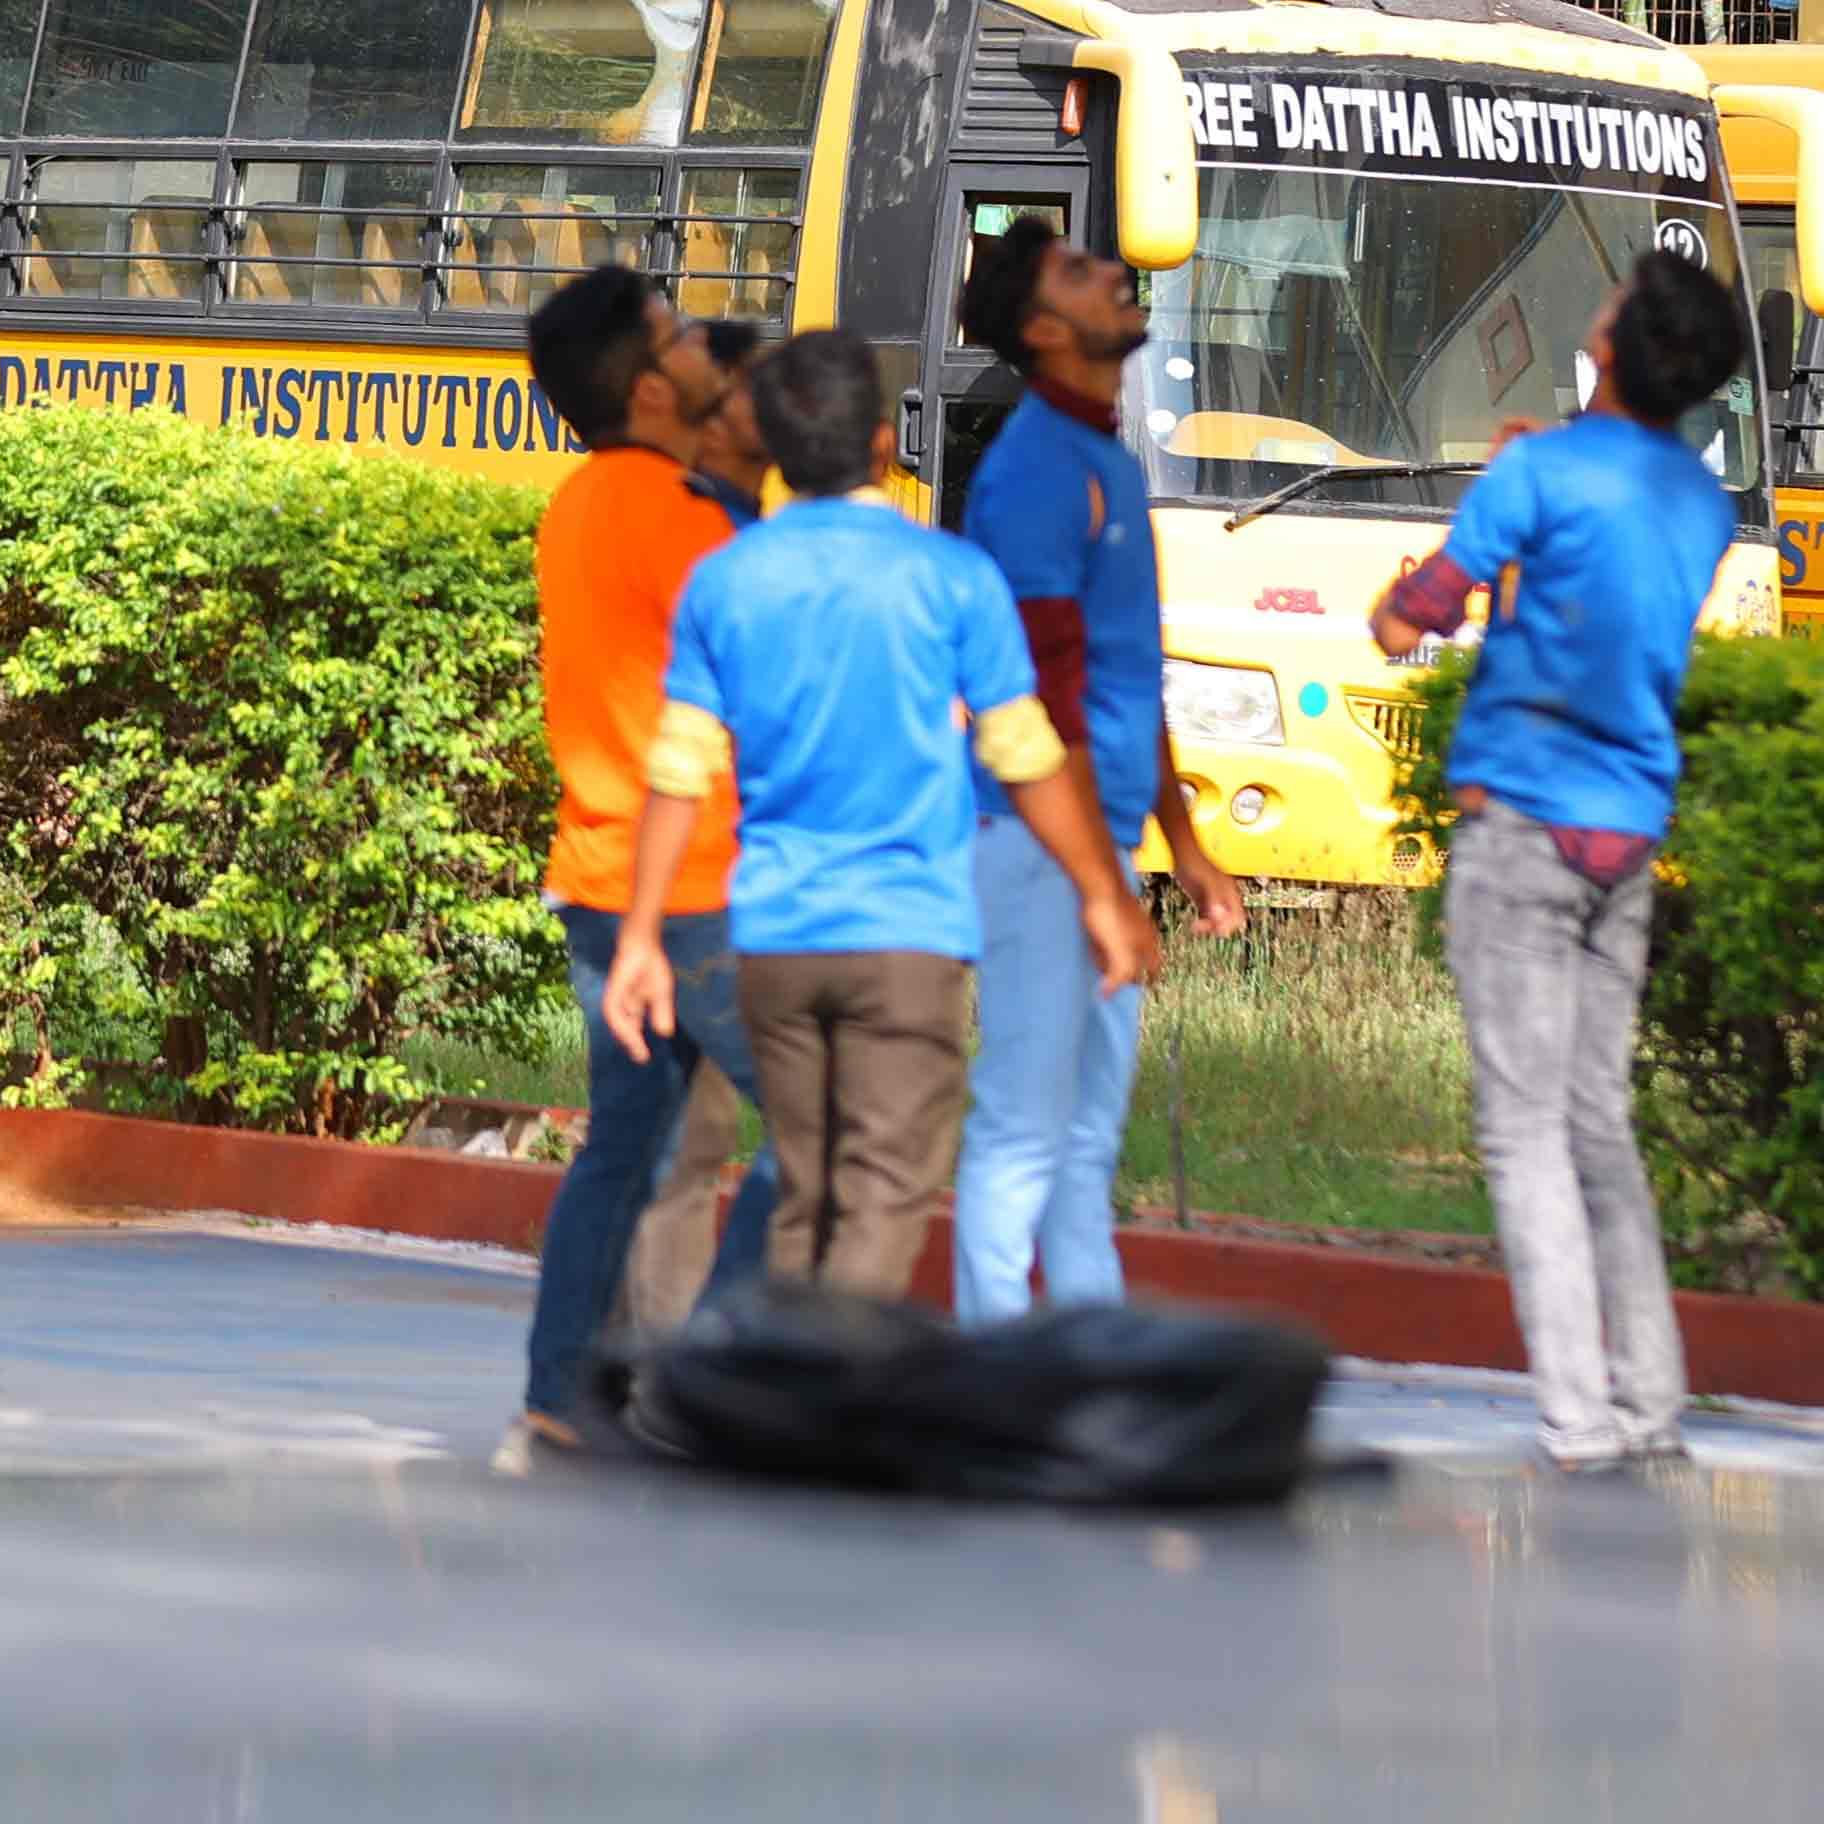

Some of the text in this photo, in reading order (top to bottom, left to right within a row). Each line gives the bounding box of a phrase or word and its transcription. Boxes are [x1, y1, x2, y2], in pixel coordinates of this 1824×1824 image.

[1271, 83, 1443, 159] DATTHA
[1451, 95, 1708, 183] INSTITUTIONS
[1254, 587, 1326, 615] JCBL
